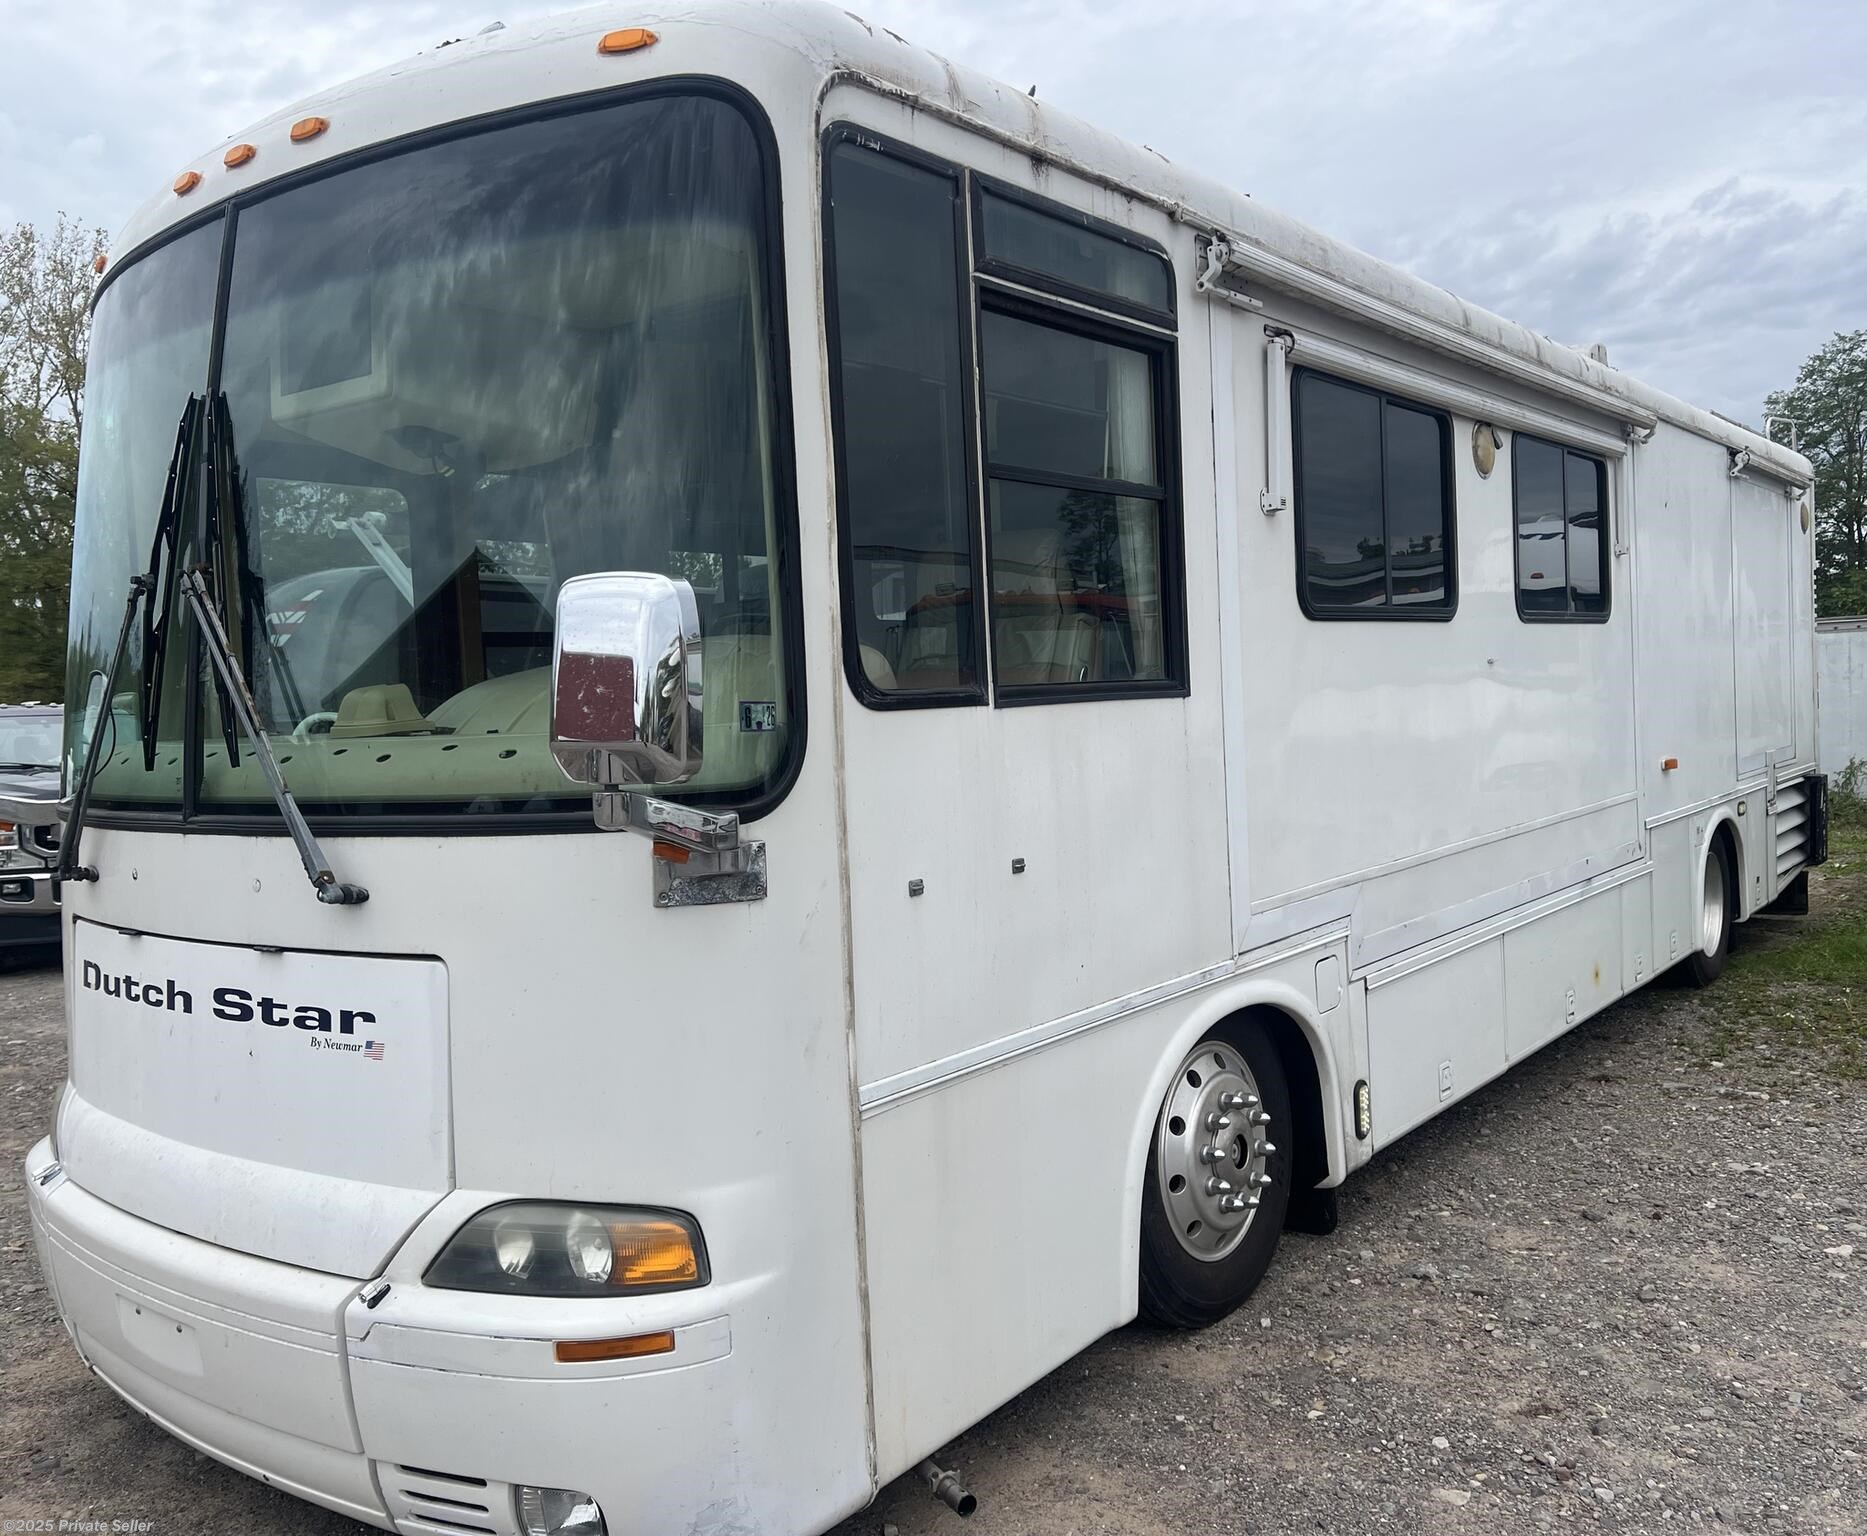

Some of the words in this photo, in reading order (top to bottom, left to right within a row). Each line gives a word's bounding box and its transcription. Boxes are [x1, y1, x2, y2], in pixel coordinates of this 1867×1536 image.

[83, 959, 192, 1014] Dutch
[212, 987, 376, 1034] Star
[310, 1036, 322, 1050] By
[323, 1037, 364, 1053] Newmar
